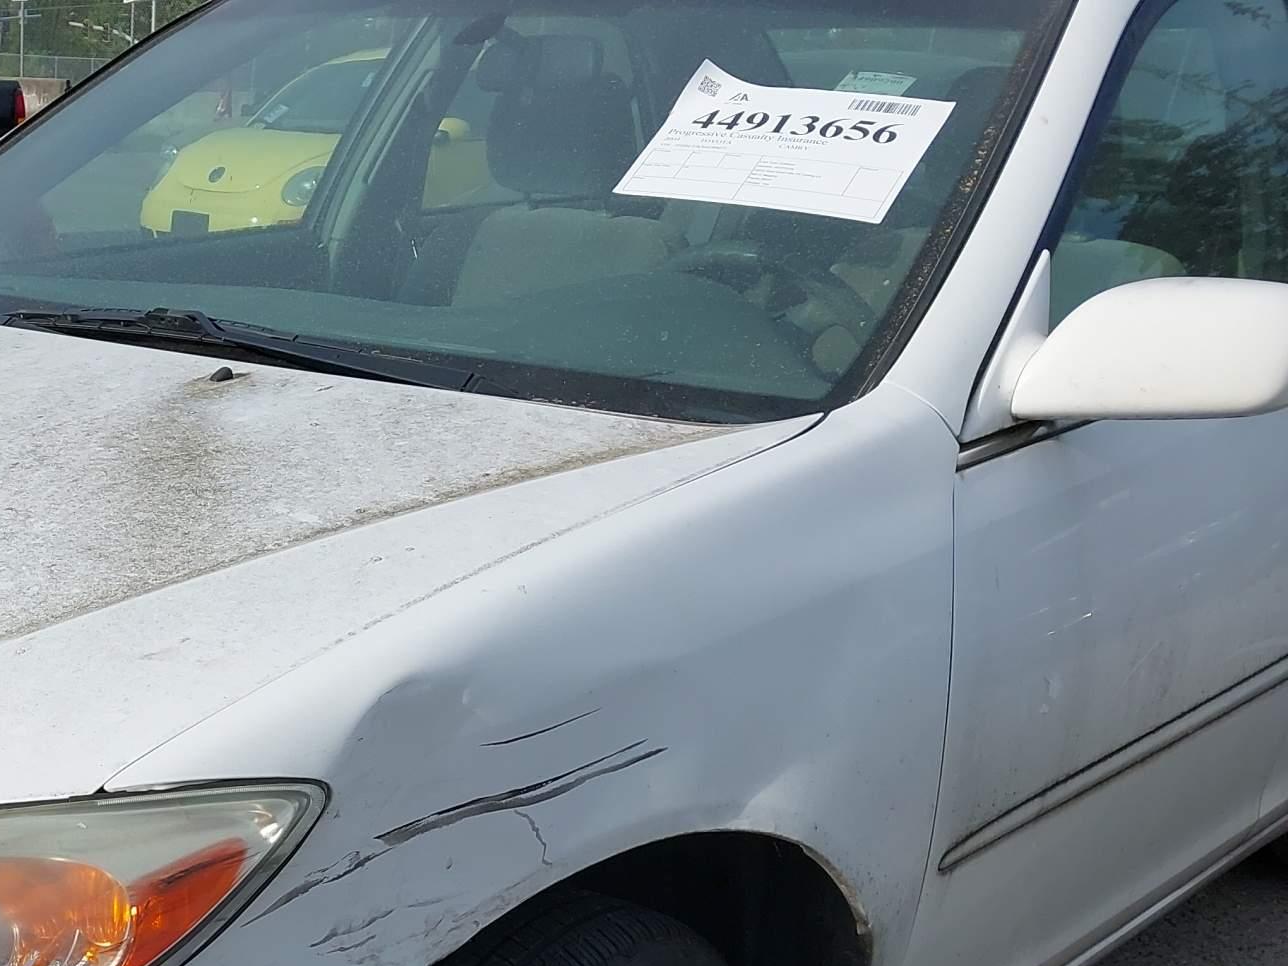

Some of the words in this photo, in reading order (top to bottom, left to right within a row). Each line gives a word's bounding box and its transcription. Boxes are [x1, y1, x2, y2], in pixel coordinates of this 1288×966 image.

[667, 127, 727, 138] Progressive
[727, 131, 774, 143] Casualty
[777, 135, 829, 146] Insurance
[692, 109, 904, 145] 44913656
